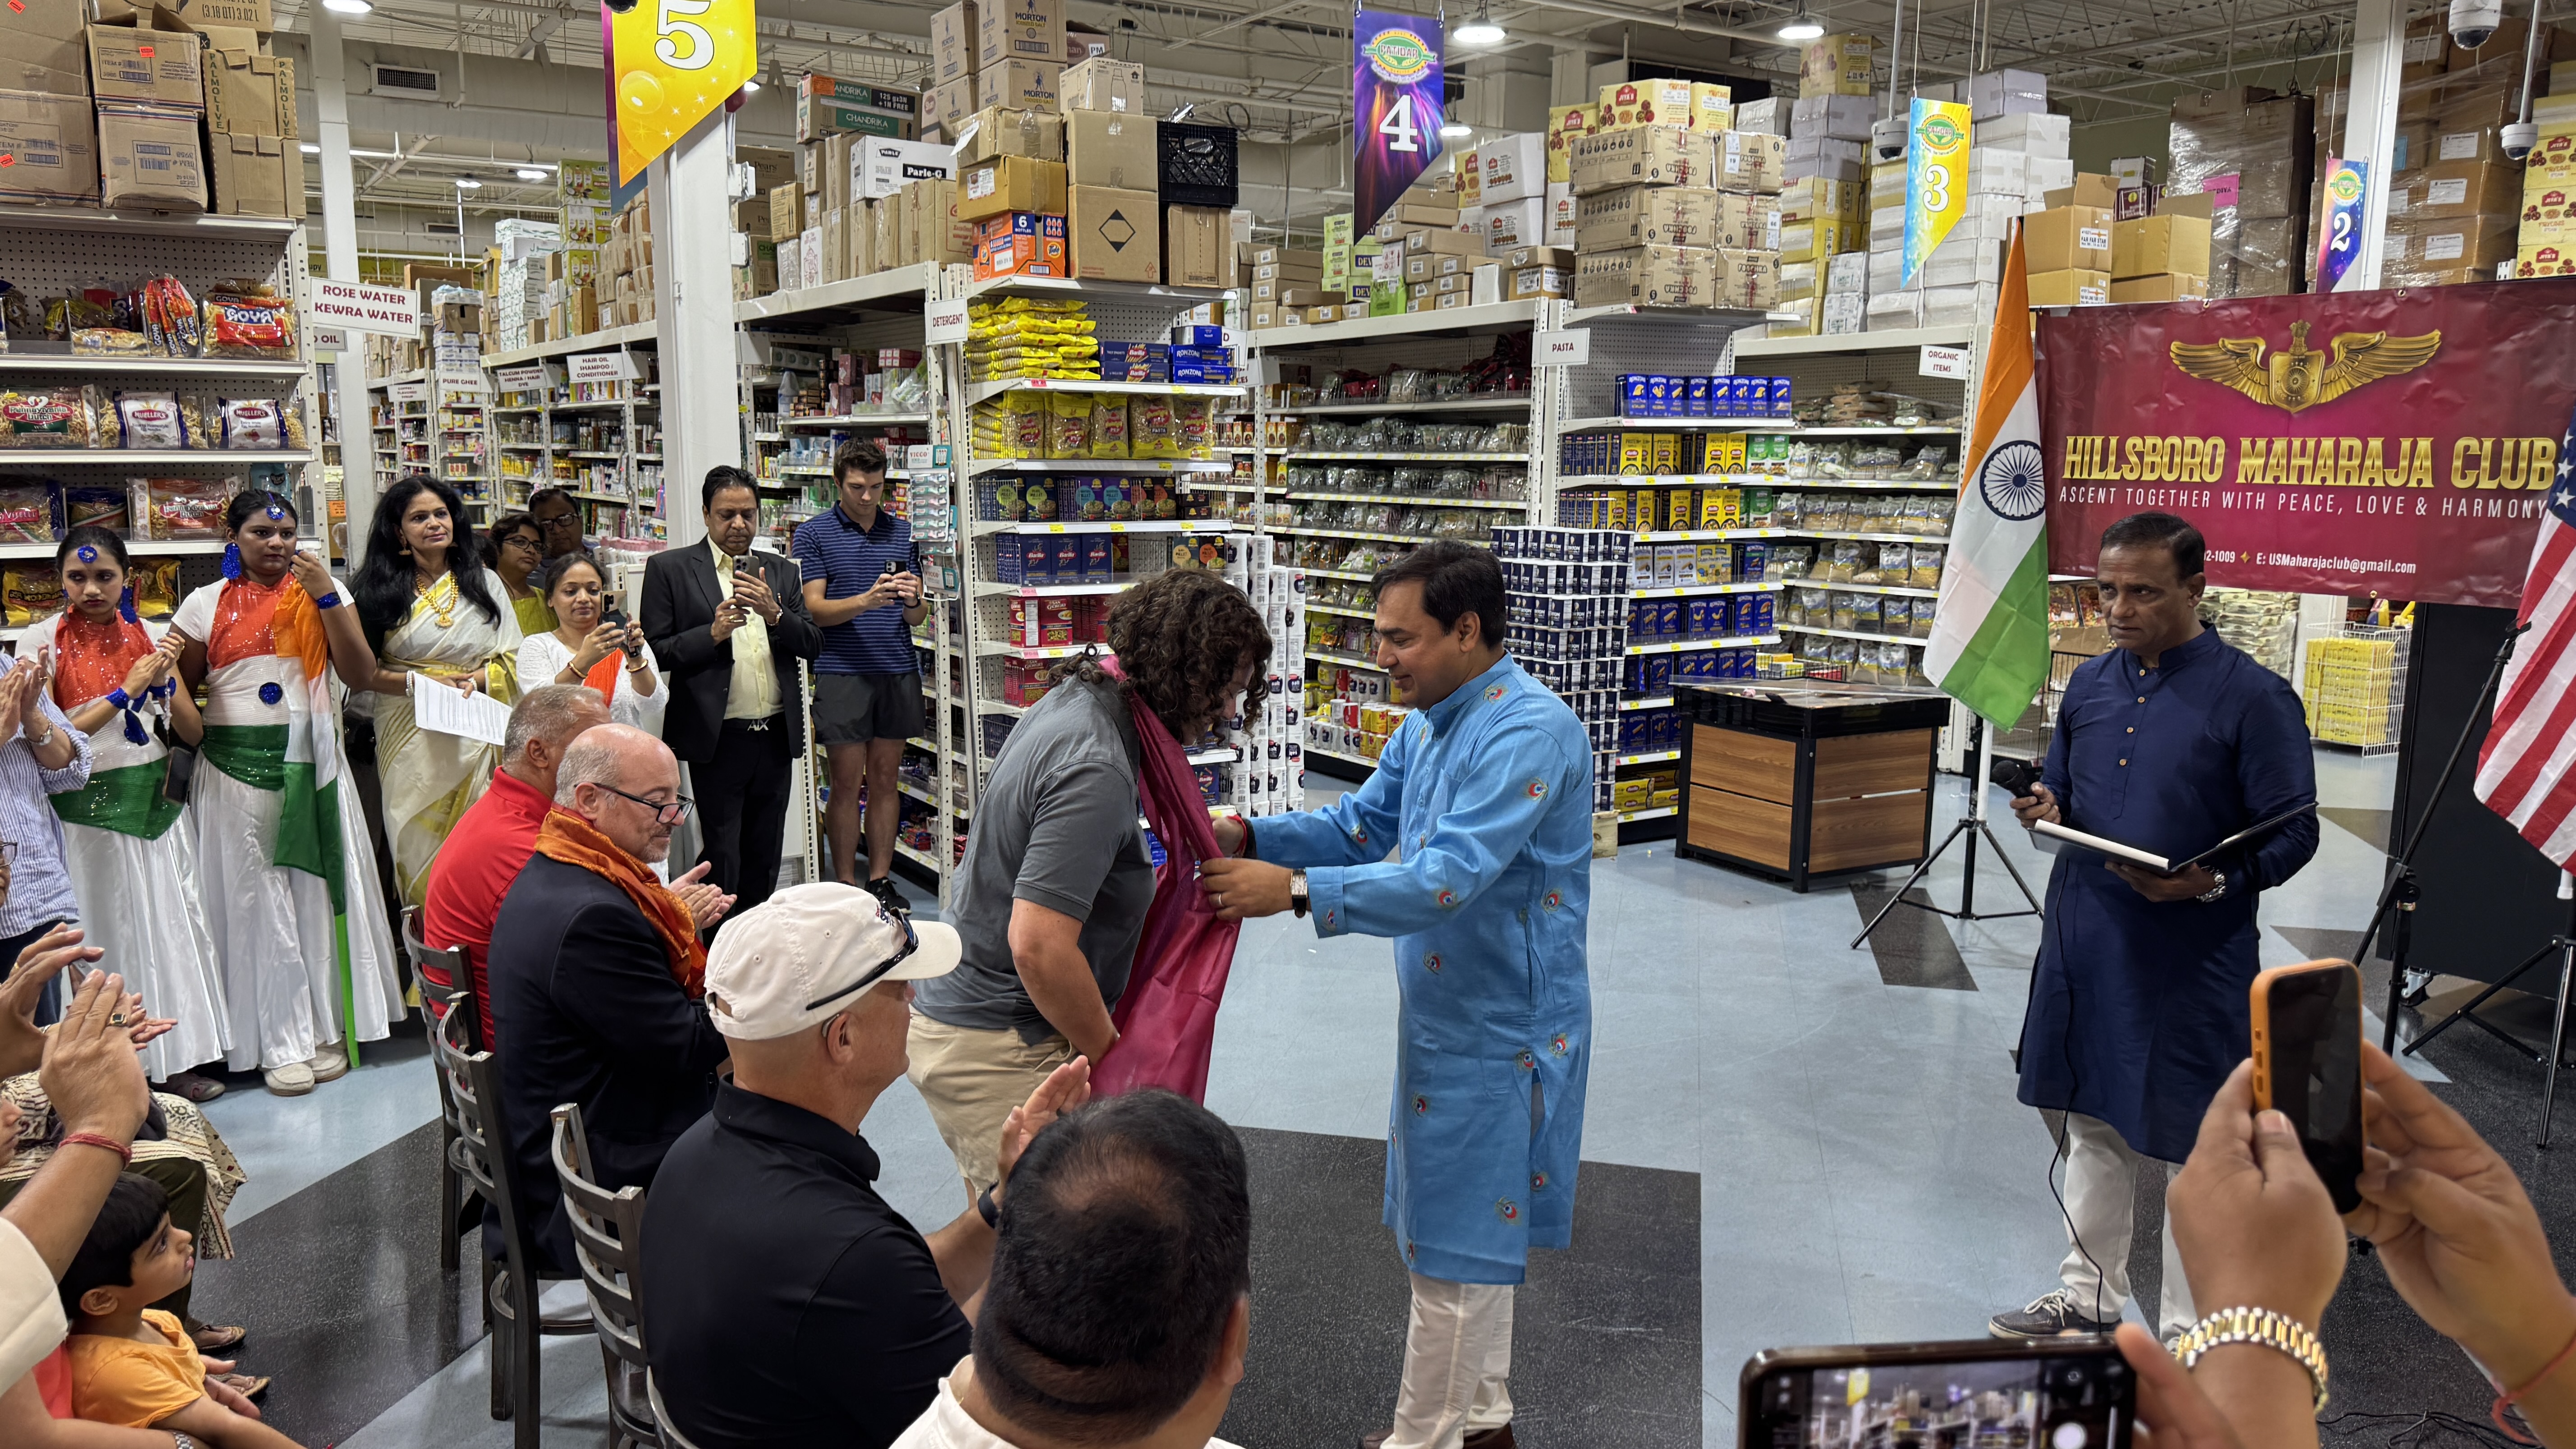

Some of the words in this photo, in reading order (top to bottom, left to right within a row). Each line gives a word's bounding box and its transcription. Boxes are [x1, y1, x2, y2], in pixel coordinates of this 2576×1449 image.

[202, 4, 221, 18] (3.18
[223, 6, 235, 20] QT)
[238, 9, 252, 21] 3.02
[255, 9, 259, 22] L
[1015, 13, 1046, 22] MORTON
[654, 0, 715, 70] 5
[1090, 46, 1103, 55] PM
[1380, 44, 1419, 60] PATIDAR
[209, 53, 224, 129] PALMOLIVE
[279, 61, 290, 135] PALMOLIVE
[835, 85, 867, 97] ANDRIKA
[1024, 90, 1054, 98] MORTON
[846, 114, 888, 128] CHANDRIKA
[1380, 95, 1418, 152] 4
[880, 149, 901, 158] PARLE
[907, 166, 942, 178] Parle-G
[1923, 164, 1949, 212] 3
[1019, 216, 1027, 228] 6
[2331, 212, 2351, 252] 2
[216, 295, 239, 303] GOYA
[323, 285, 355, 298] ROSE
[360, 290, 405, 305] WATER
[227, 308, 272, 323] GOYA
[315, 302, 363, 317] KEWRA
[368, 309, 413, 323] WATER
[933, 313, 963, 327] DETERGENT
[152, 324, 162, 346] GOYA
[1552, 342, 1573, 352] PASTA
[1928, 350, 1958, 360] ORGANIC
[1933, 364, 1950, 372] ITEMS
[135, 410, 167, 419] MUELLER'S
[2062, 436, 2226, 483] HILLSBORO
[2235, 437, 2434, 488] MAHARAJA
[2451, 437, 2556, 490] CLUB
[2060, 487, 2116, 504] ASCENT
[2126, 488, 2210, 507] TOGETHER
[2222, 492, 2265, 510] WITH
[2278, 493, 2342, 515] PEACE,
[2356, 496, 2405, 515] LOVE
[2416, 497, 2427, 515] &
[2442, 498, 2548, 519] HARMONY
[2257, 553, 2265, 565] E:
[2269, 553, 2416, 574] USMaharajaclub@gmail.com
